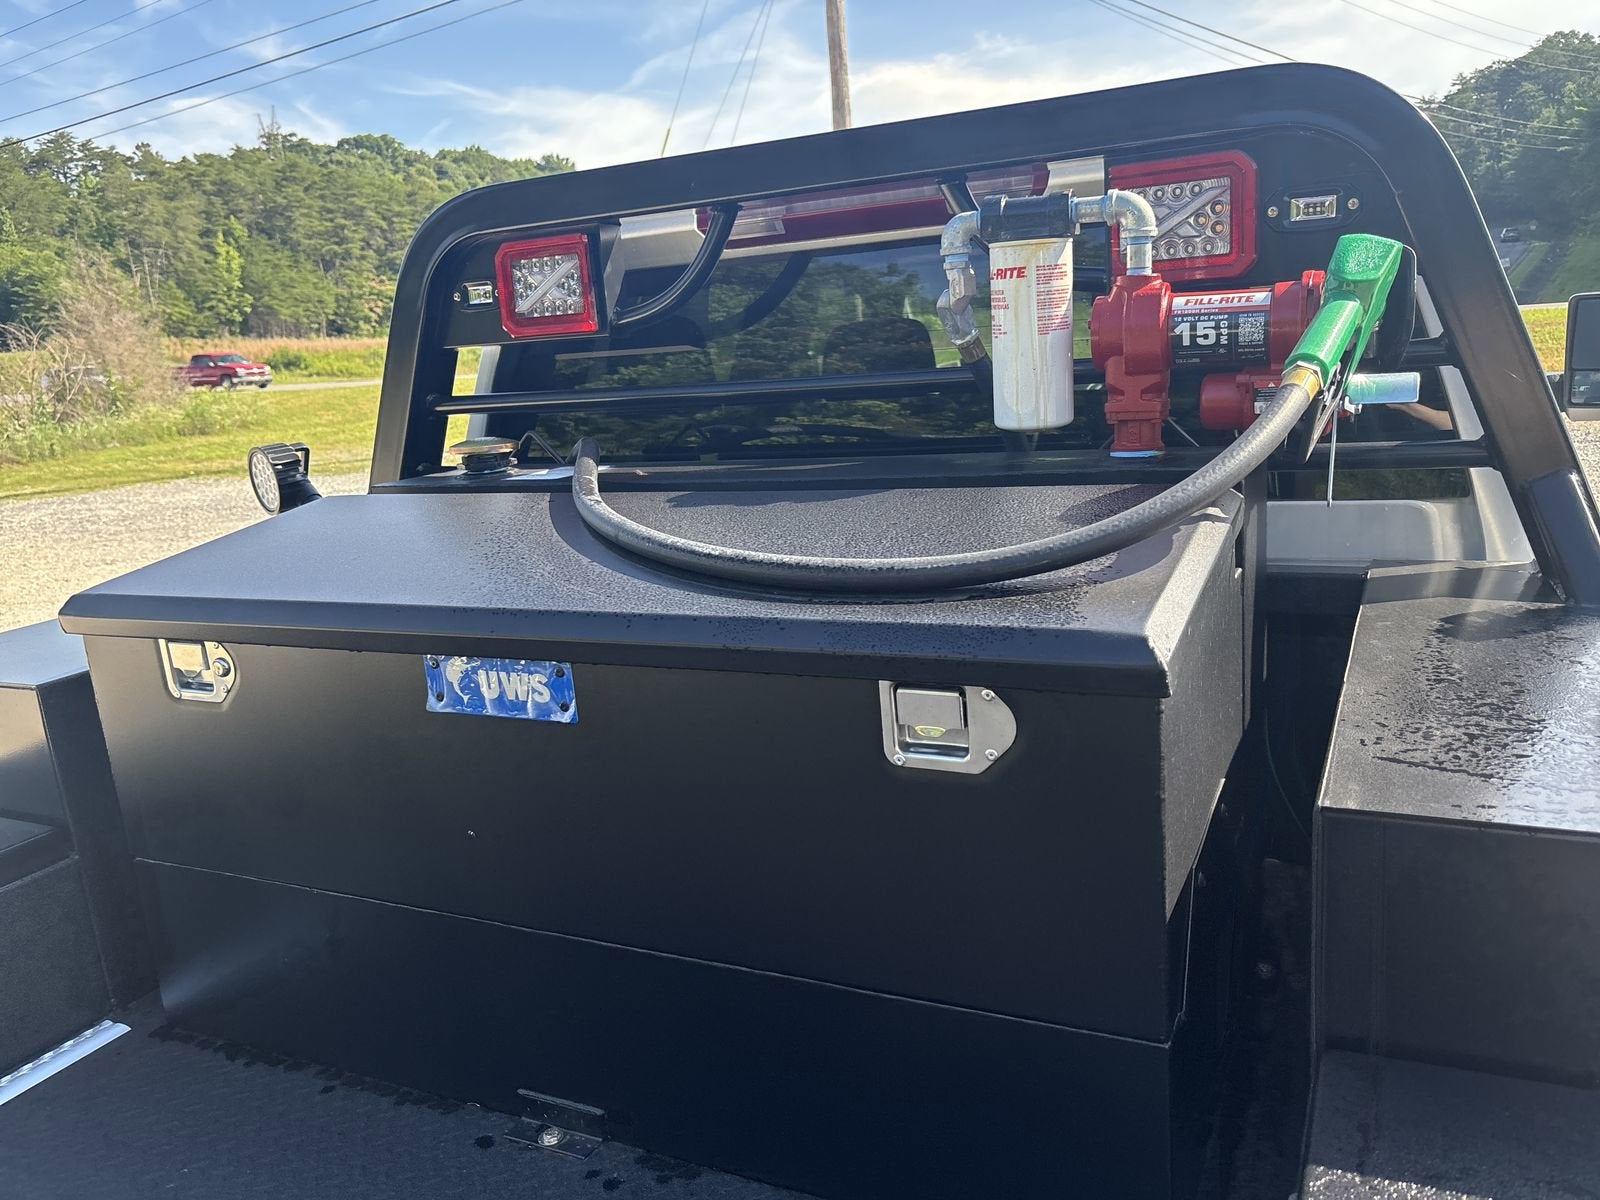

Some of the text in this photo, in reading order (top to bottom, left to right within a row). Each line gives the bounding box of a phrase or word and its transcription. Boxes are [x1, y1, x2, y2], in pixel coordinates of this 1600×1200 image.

[1184, 295, 1256, 306] FILL-RITE
[1174, 321, 1216, 346] 15
[1219, 320, 1228, 345] GPM
[478, 669, 551, 703] UWS
